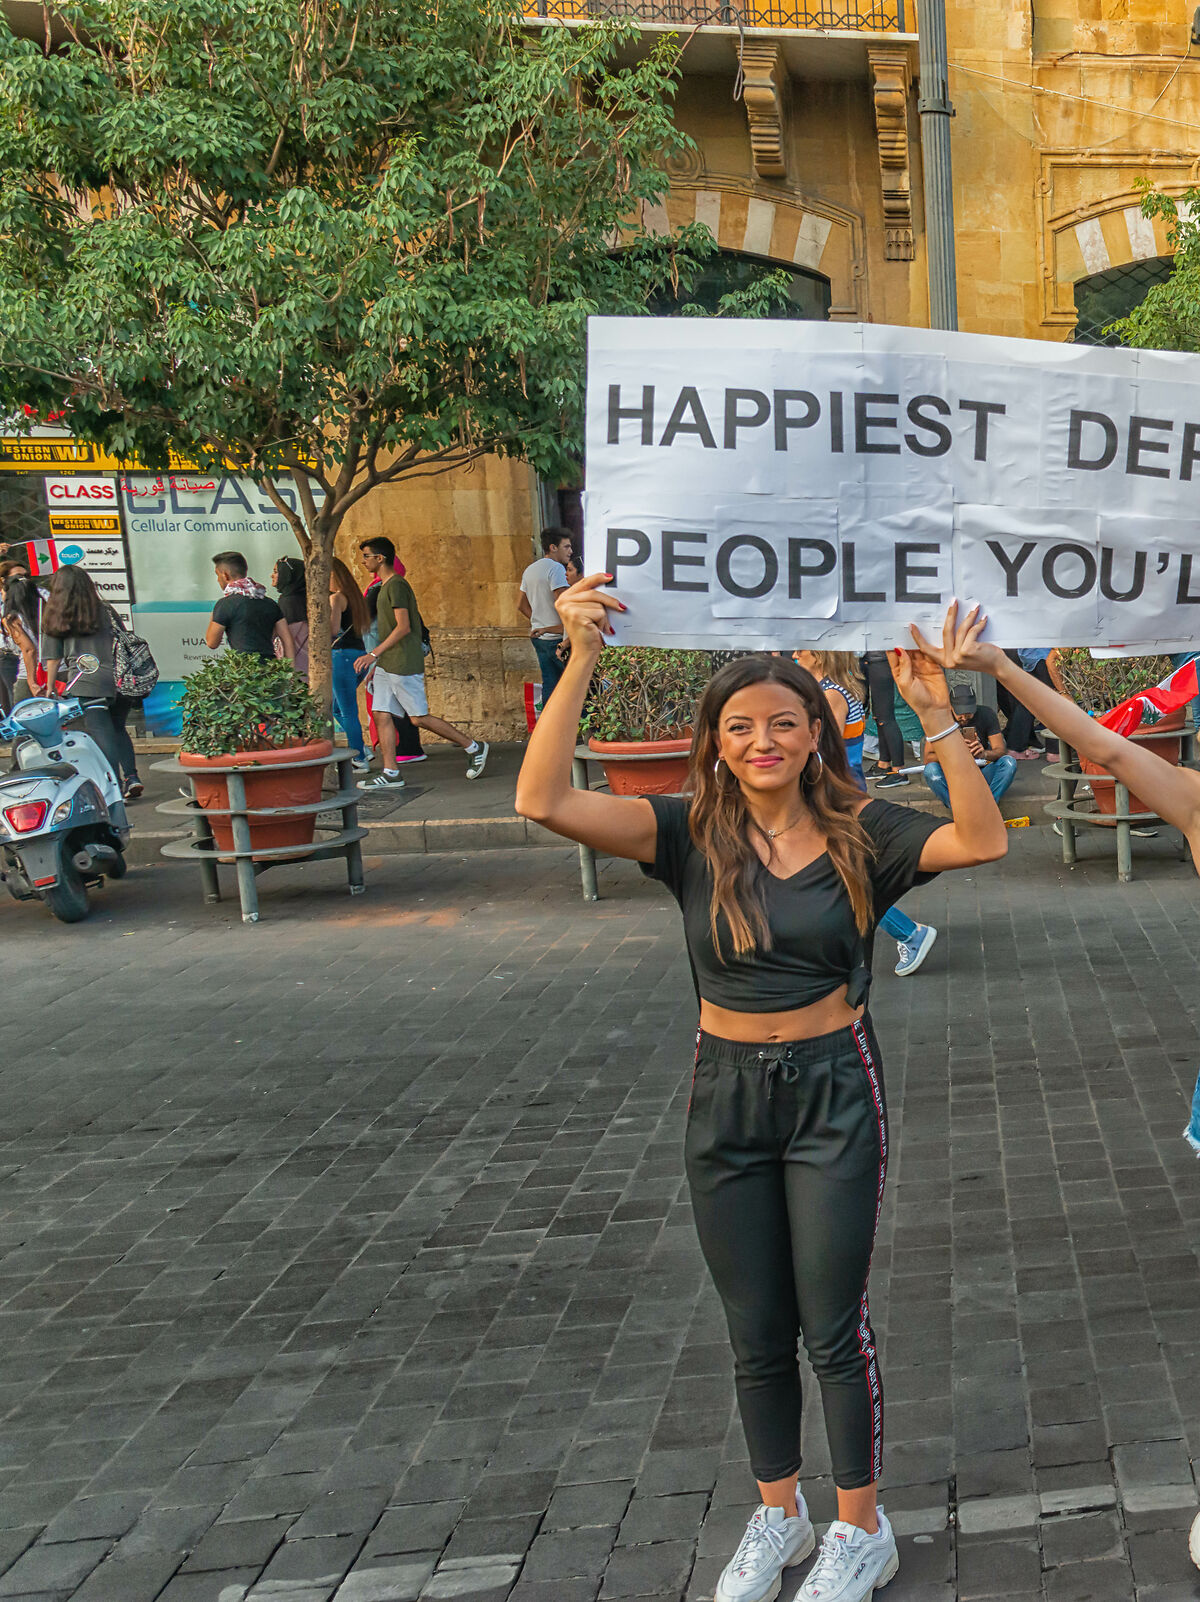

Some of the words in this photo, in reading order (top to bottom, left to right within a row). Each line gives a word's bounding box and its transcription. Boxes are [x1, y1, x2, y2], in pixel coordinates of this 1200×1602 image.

[607, 384, 1006, 462] HAPPIEST
[13, 453, 52, 461] UNION
[49, 484, 114, 499] CLASS
[120, 476, 165, 497] فورية
[169, 475, 216, 494] صيانة
[131, 519, 181, 532] Cellular
[604, 528, 942, 605] PEOPLE
[182, 637, 228, 646] HUAE
